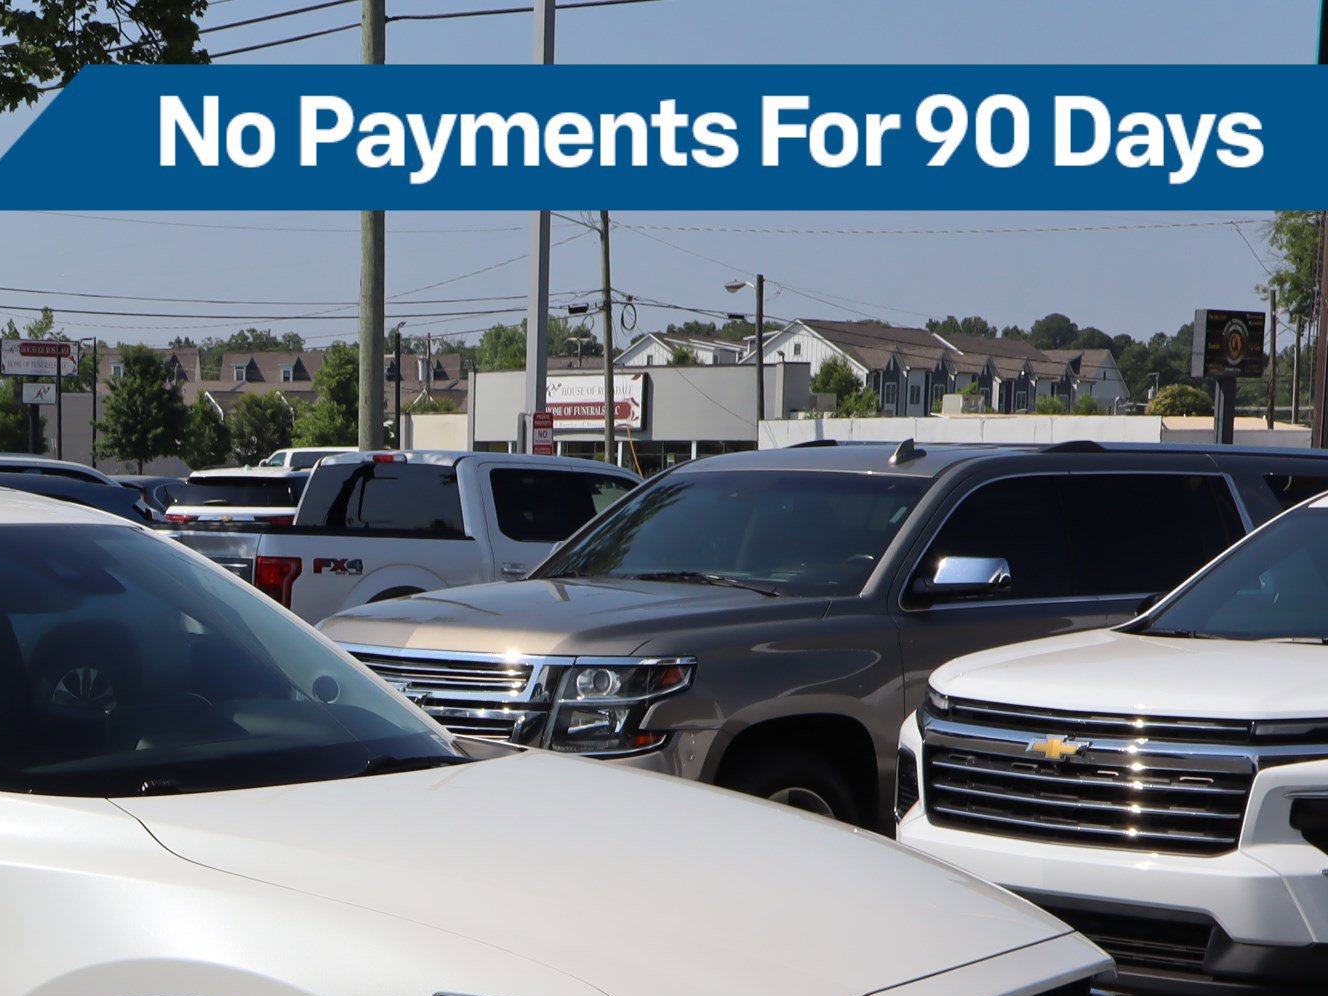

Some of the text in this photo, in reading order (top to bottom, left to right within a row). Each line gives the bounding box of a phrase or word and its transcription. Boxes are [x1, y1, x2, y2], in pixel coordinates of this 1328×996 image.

[563, 406, 573, 416] OF
[573, 406, 605, 416] FUNERALS
[538, 430, 548, 439] NO
[313, 558, 363, 575] FX4
